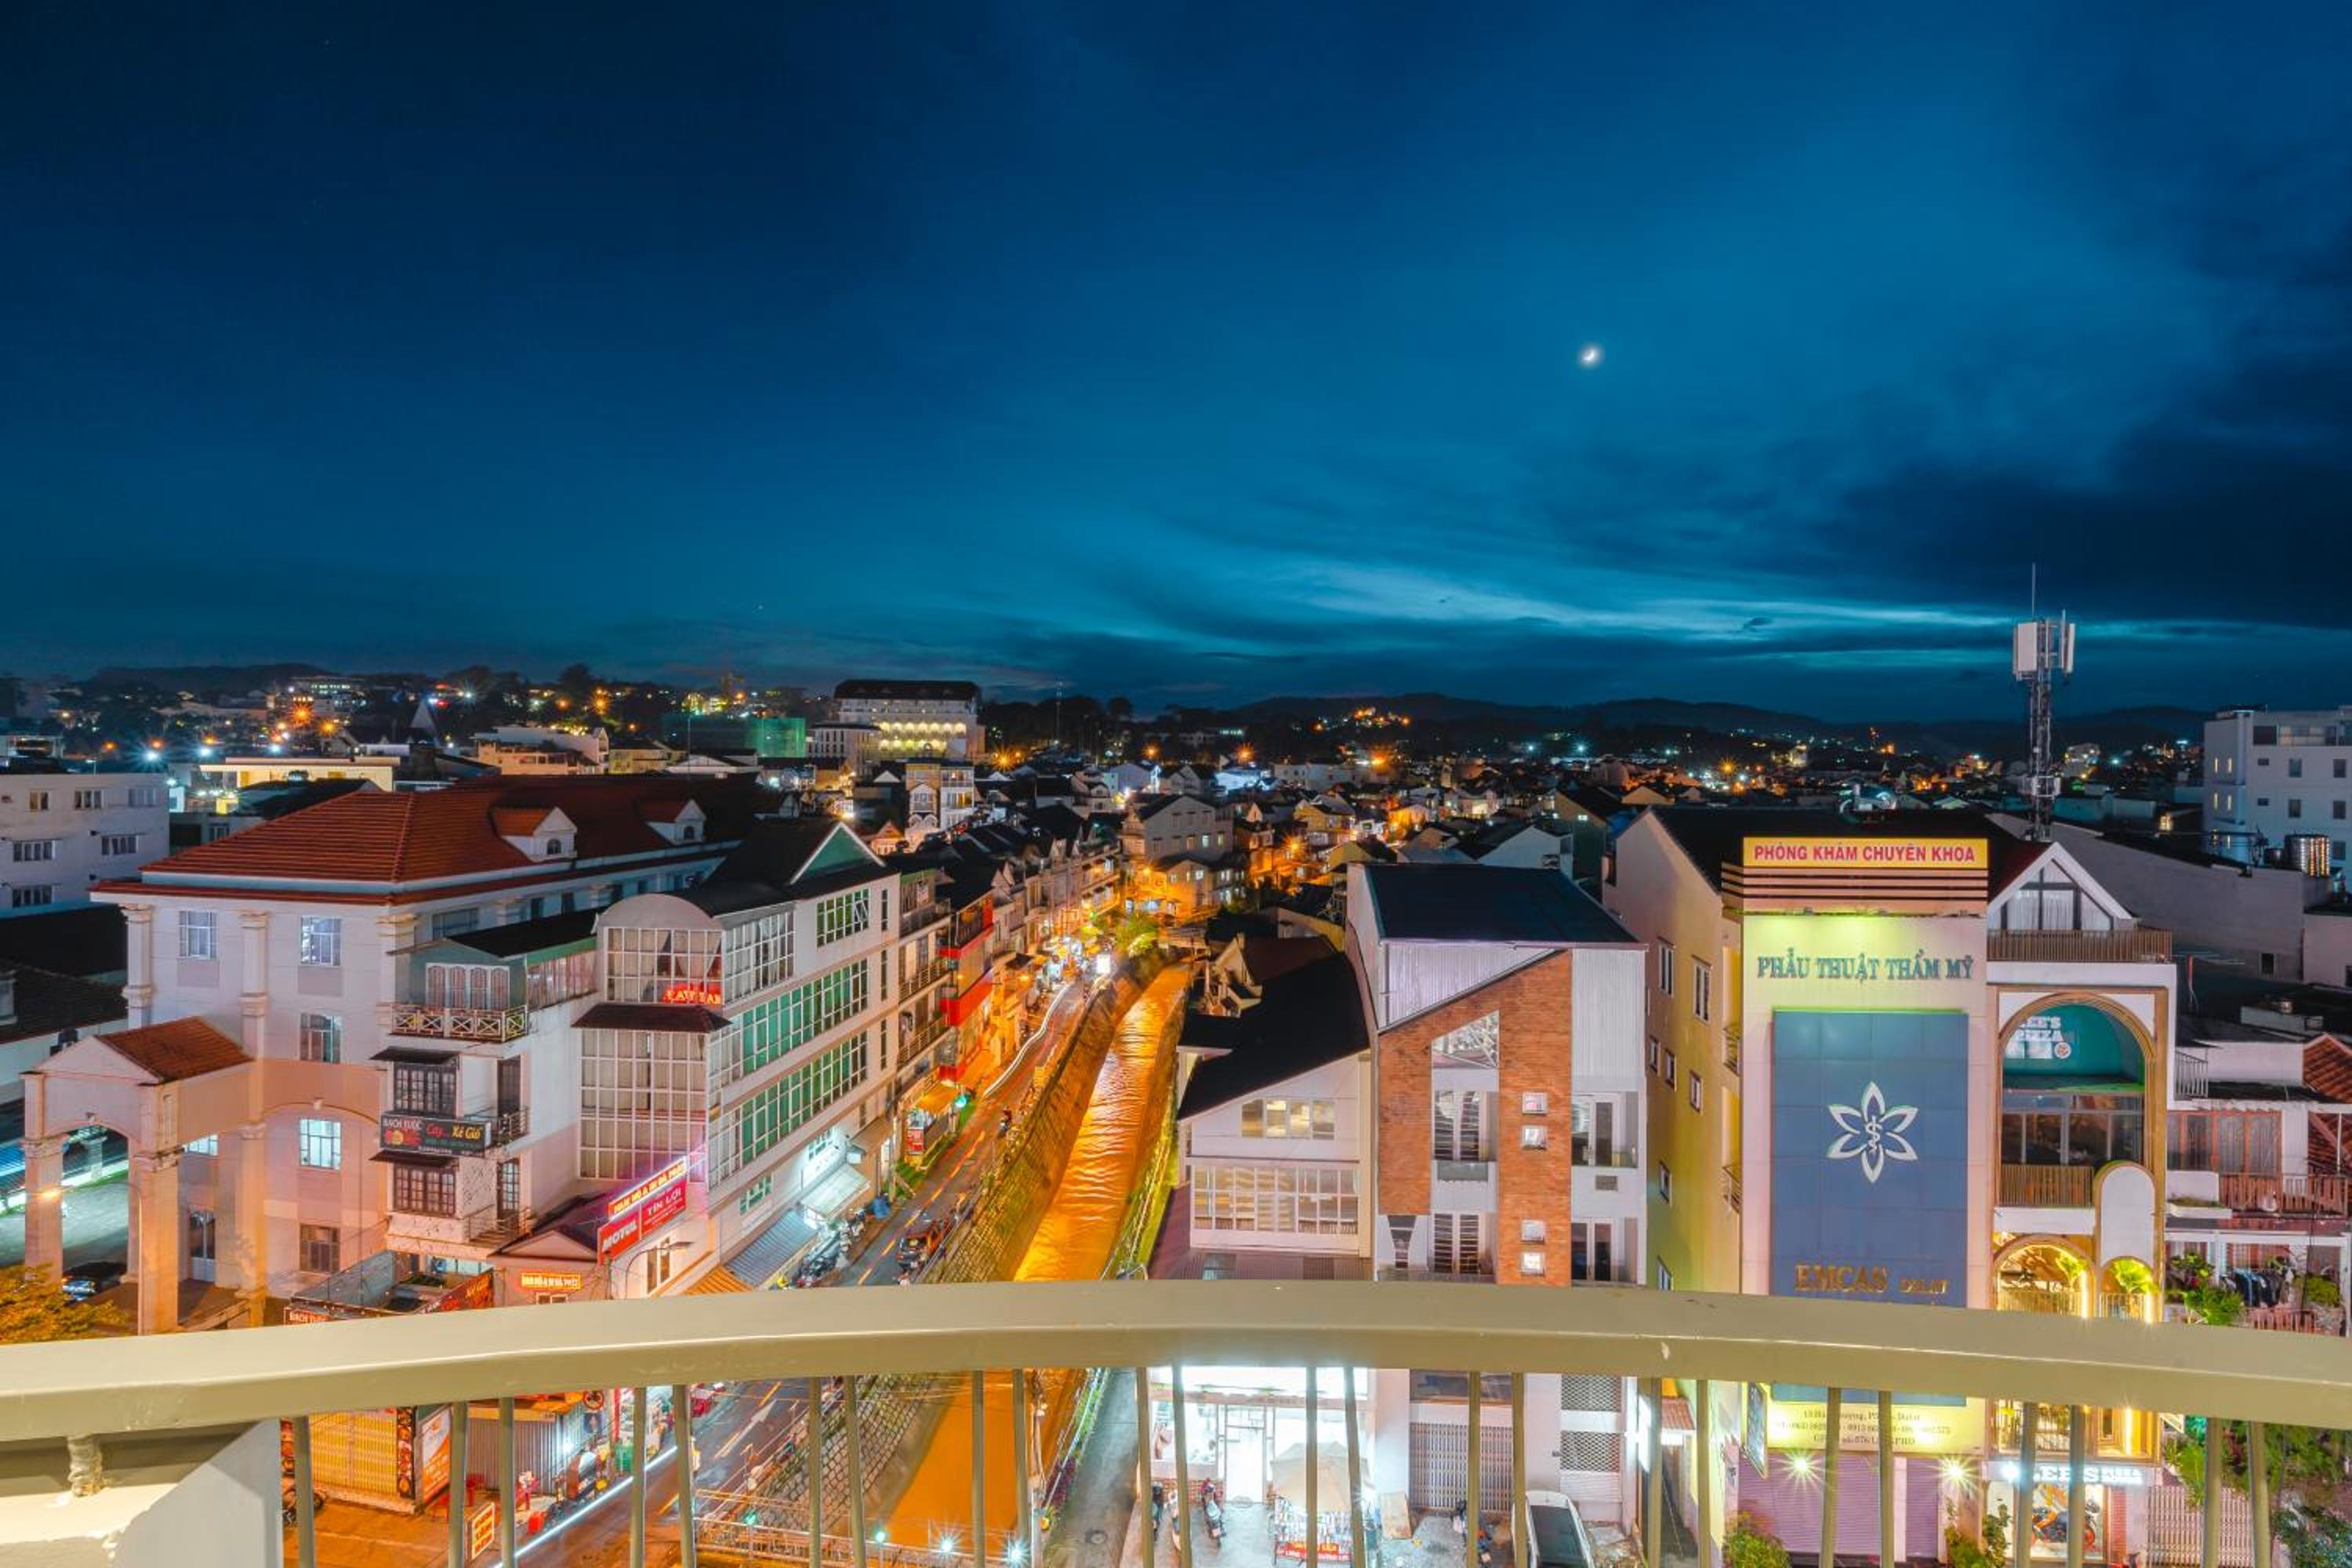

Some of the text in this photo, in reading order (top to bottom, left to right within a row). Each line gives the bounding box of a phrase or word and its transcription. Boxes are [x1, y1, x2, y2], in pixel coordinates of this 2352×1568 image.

[1755, 841, 1975, 862] PHÒNG KHÁM CHUYÊN KHOA
[2020, 1016, 2060, 1029] EE'S
[2034, 1465, 2100, 1483] EES
